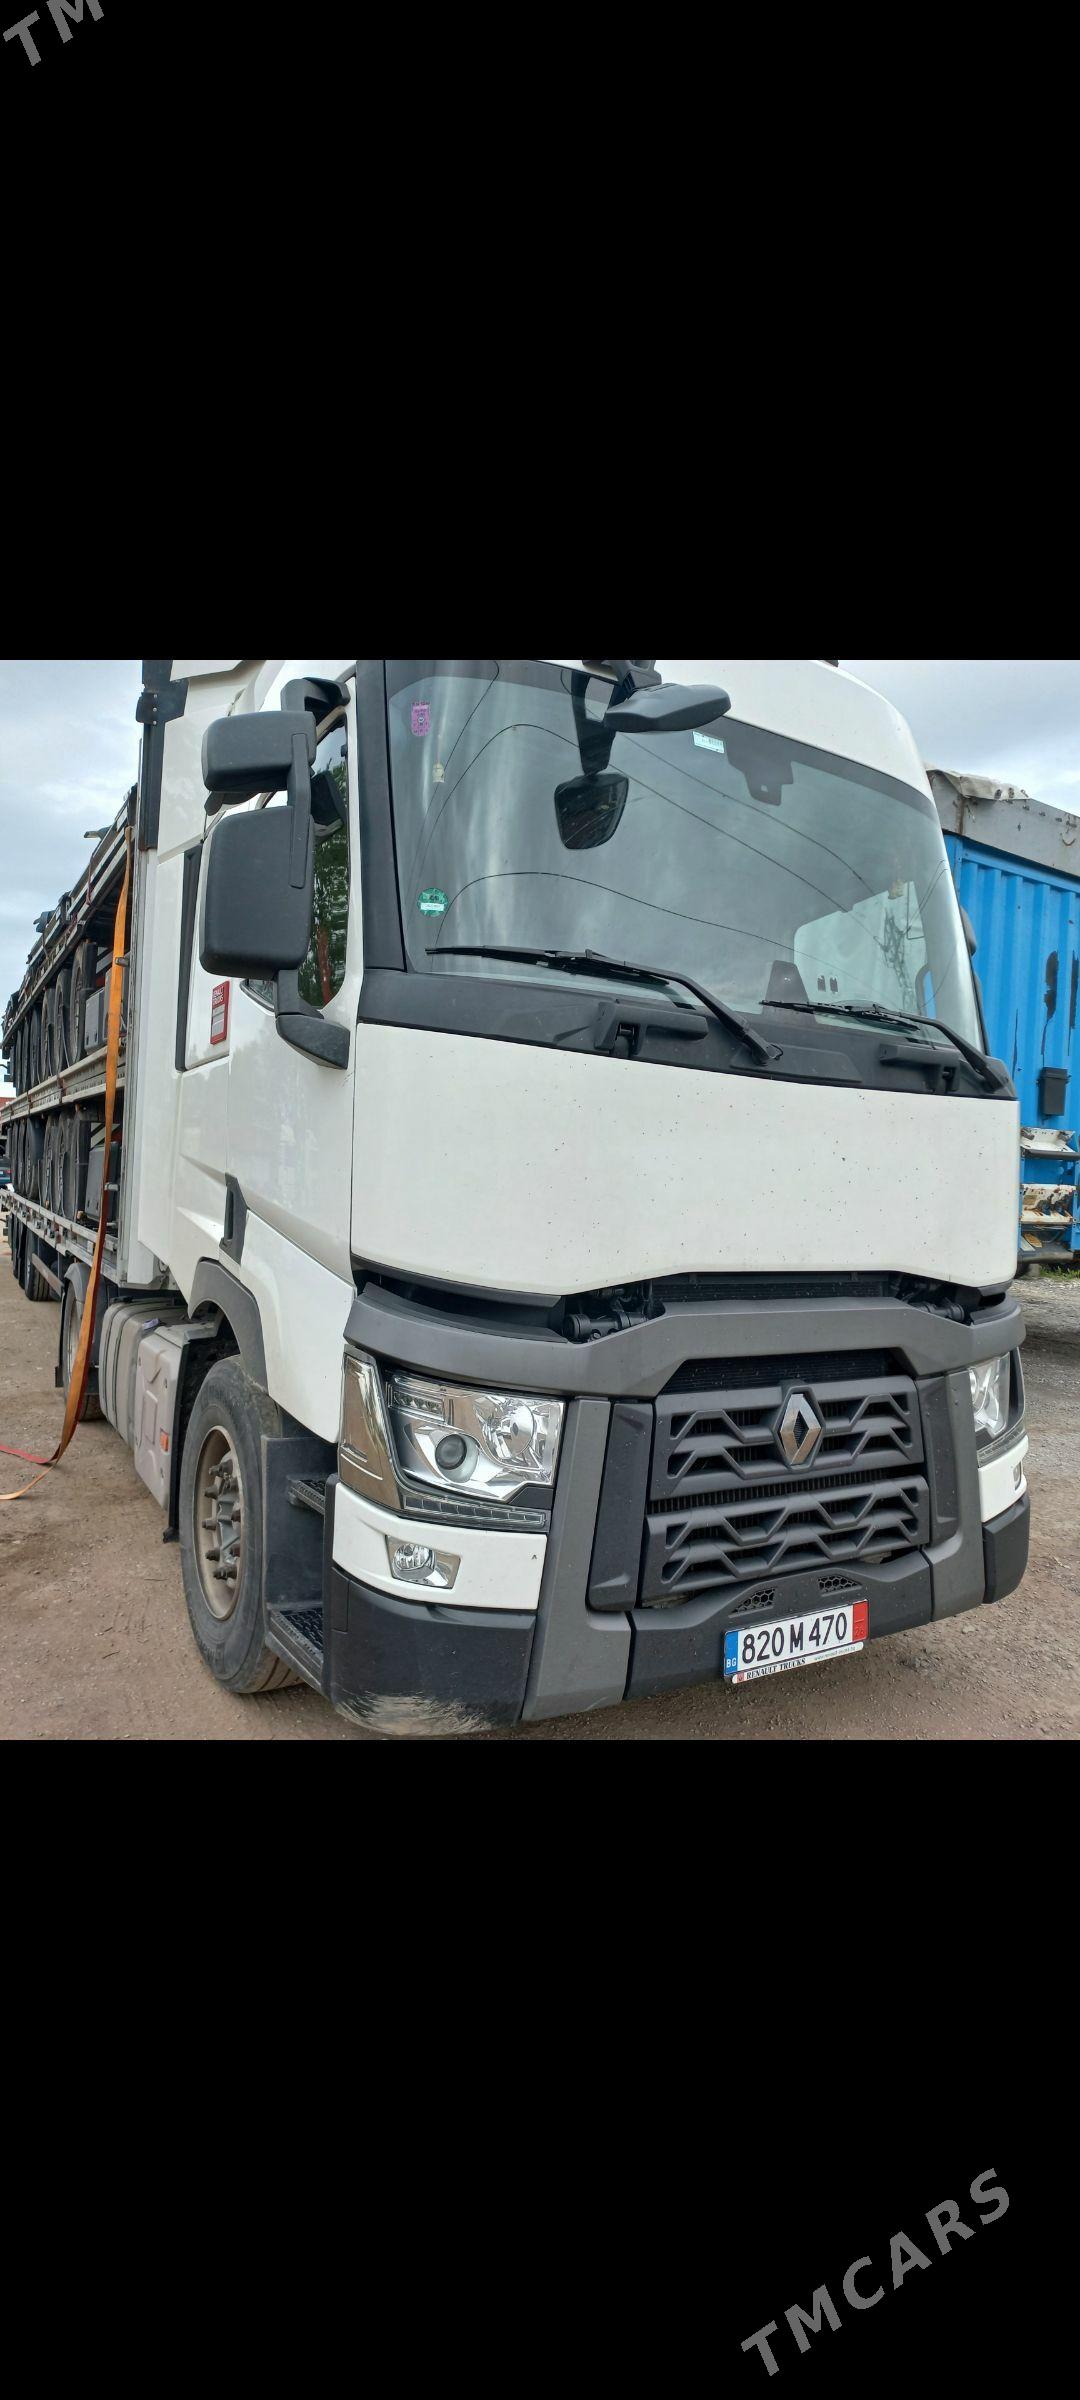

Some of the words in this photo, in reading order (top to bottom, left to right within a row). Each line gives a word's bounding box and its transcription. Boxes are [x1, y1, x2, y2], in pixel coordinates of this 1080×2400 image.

[742, 1627, 785, 1664] 820
[789, 1622, 804, 1653] M
[809, 1612, 848, 1647] 470
[726, 1657, 737, 1668] BG
[746, 1664, 778, 1680] RENAULT
[780, 1657, 806, 1671] TRUCKS
